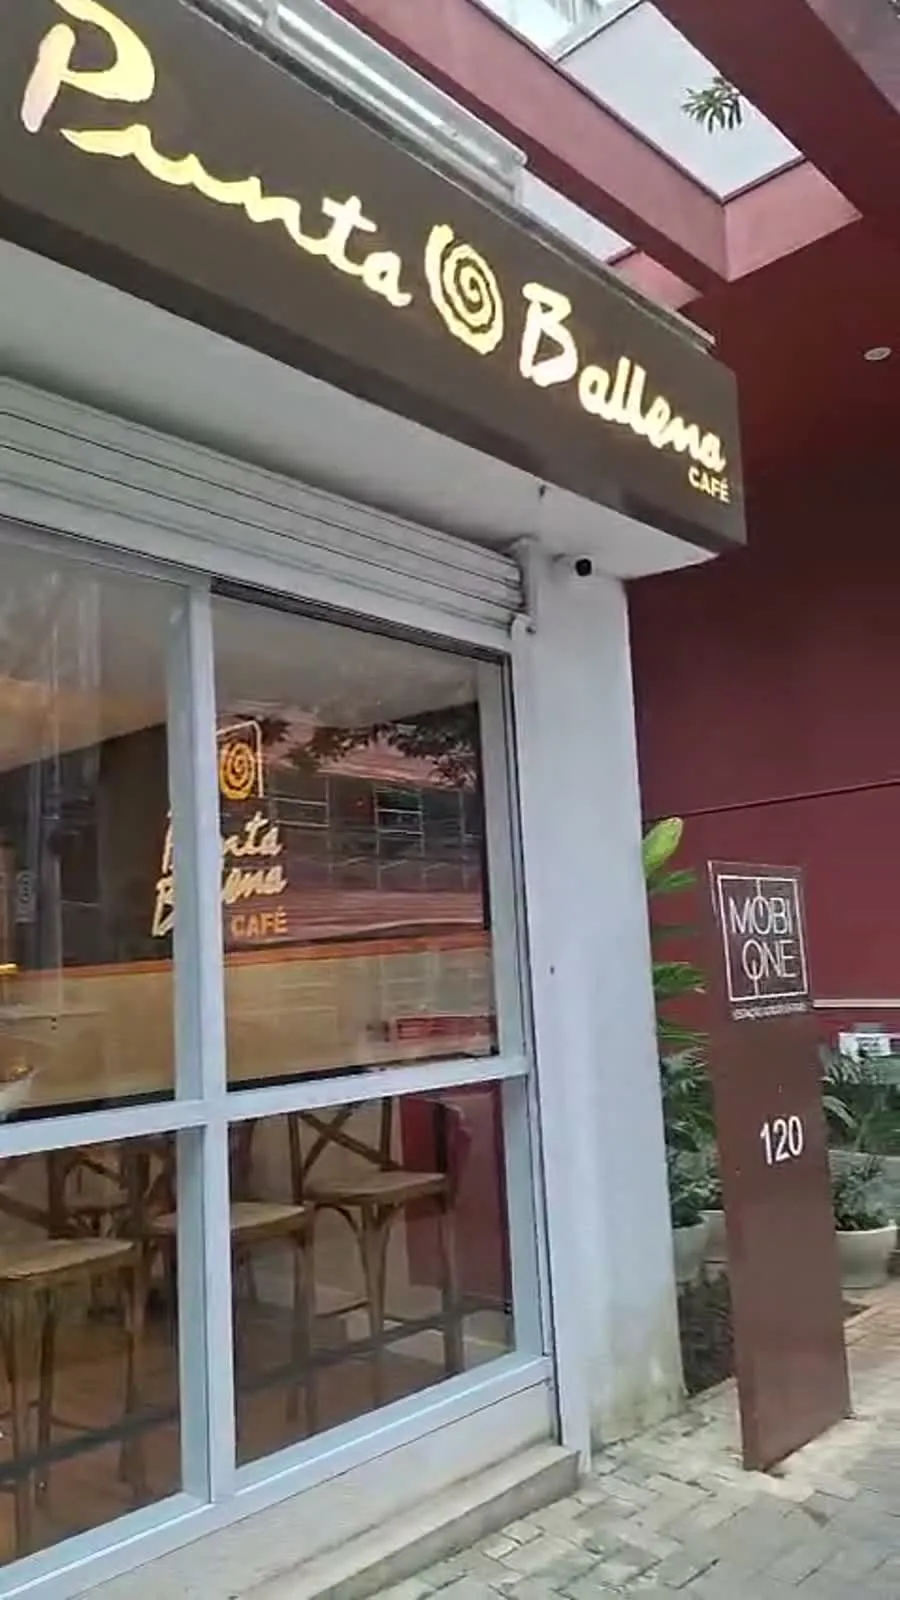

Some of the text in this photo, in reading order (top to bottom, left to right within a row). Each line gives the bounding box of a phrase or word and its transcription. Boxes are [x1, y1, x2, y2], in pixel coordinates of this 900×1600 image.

[20, 0, 726, 472] Punta Ballena
[687, 465, 731, 505] CAFÉ
[231, 905, 288, 937] CAFÉ
[729, 895, 793, 936] MOBI
[741, 938, 797, 980] ONE
[760, 1115, 803, 1166] 120
